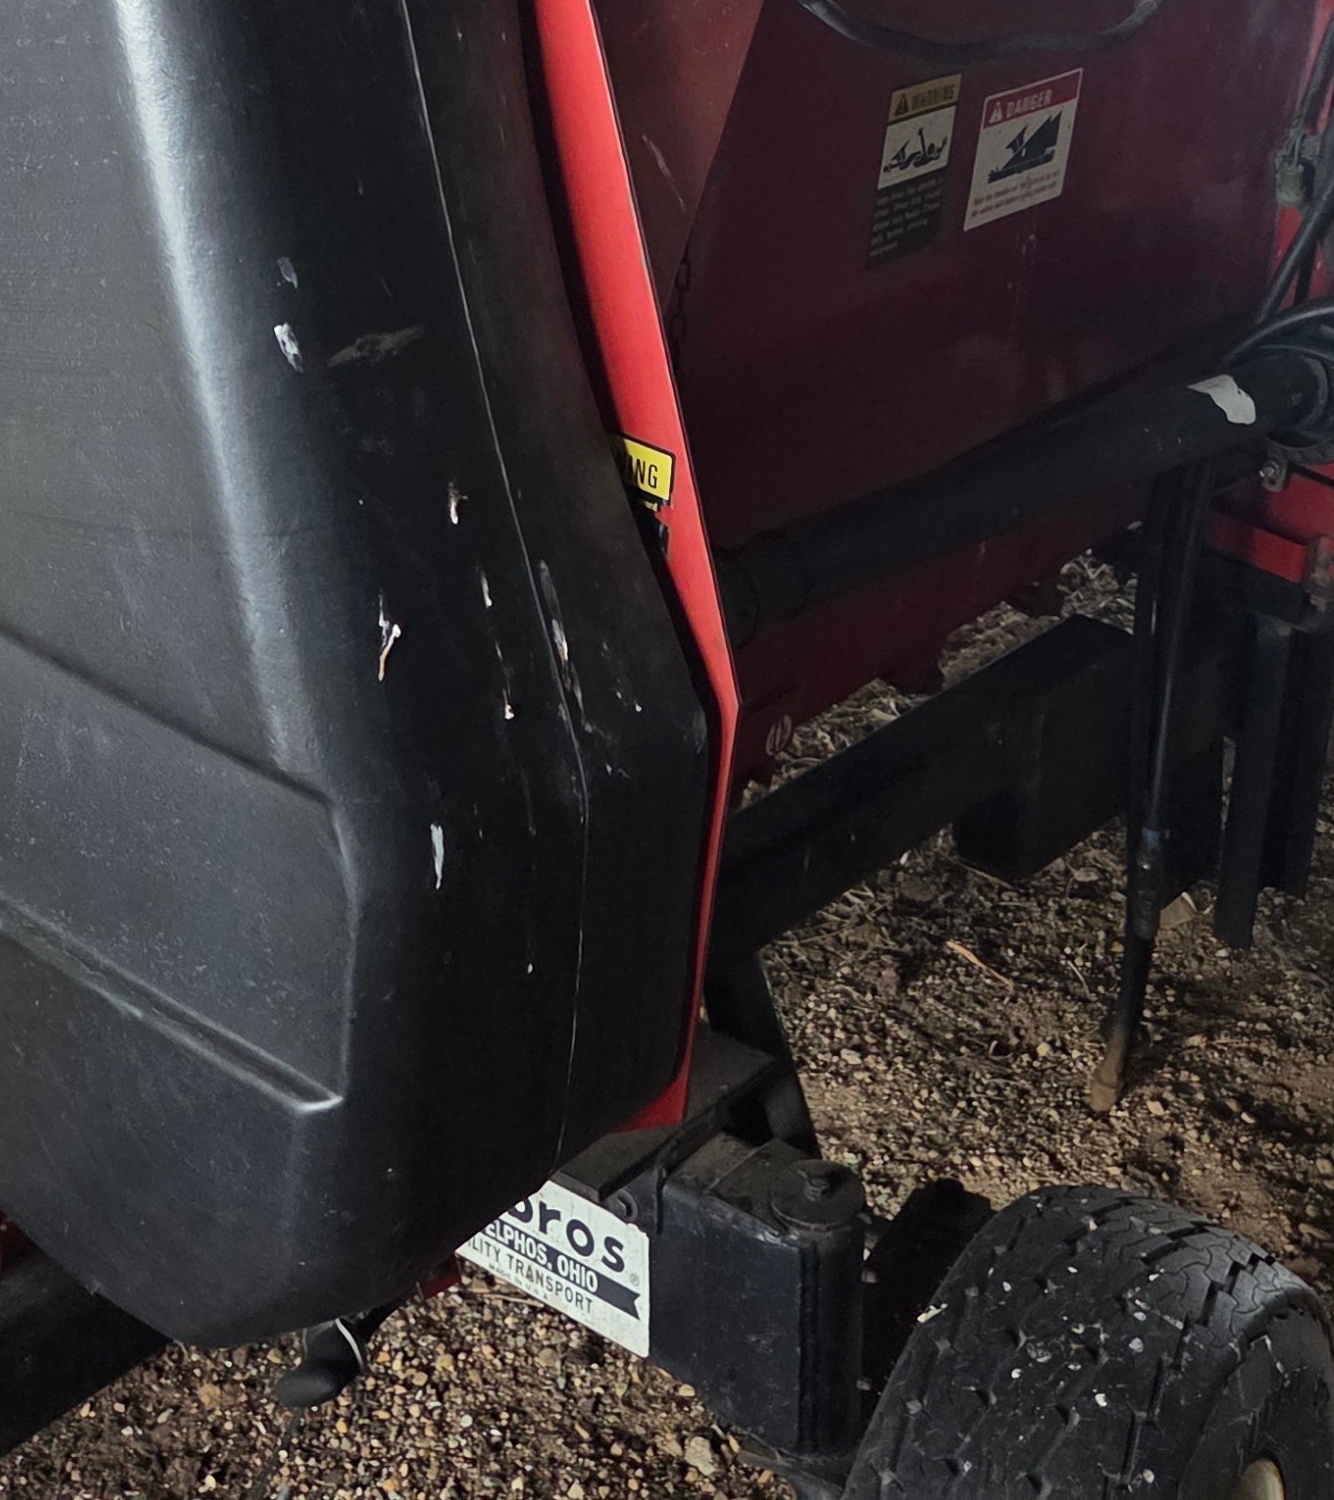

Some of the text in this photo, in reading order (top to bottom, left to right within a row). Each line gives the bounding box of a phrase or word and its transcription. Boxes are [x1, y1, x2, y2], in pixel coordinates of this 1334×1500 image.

[1005, 88, 1053, 119] DANGER
[507, 1252, 593, 1314] TRANSPORT
[556, 1254, 599, 1293] OHIO
